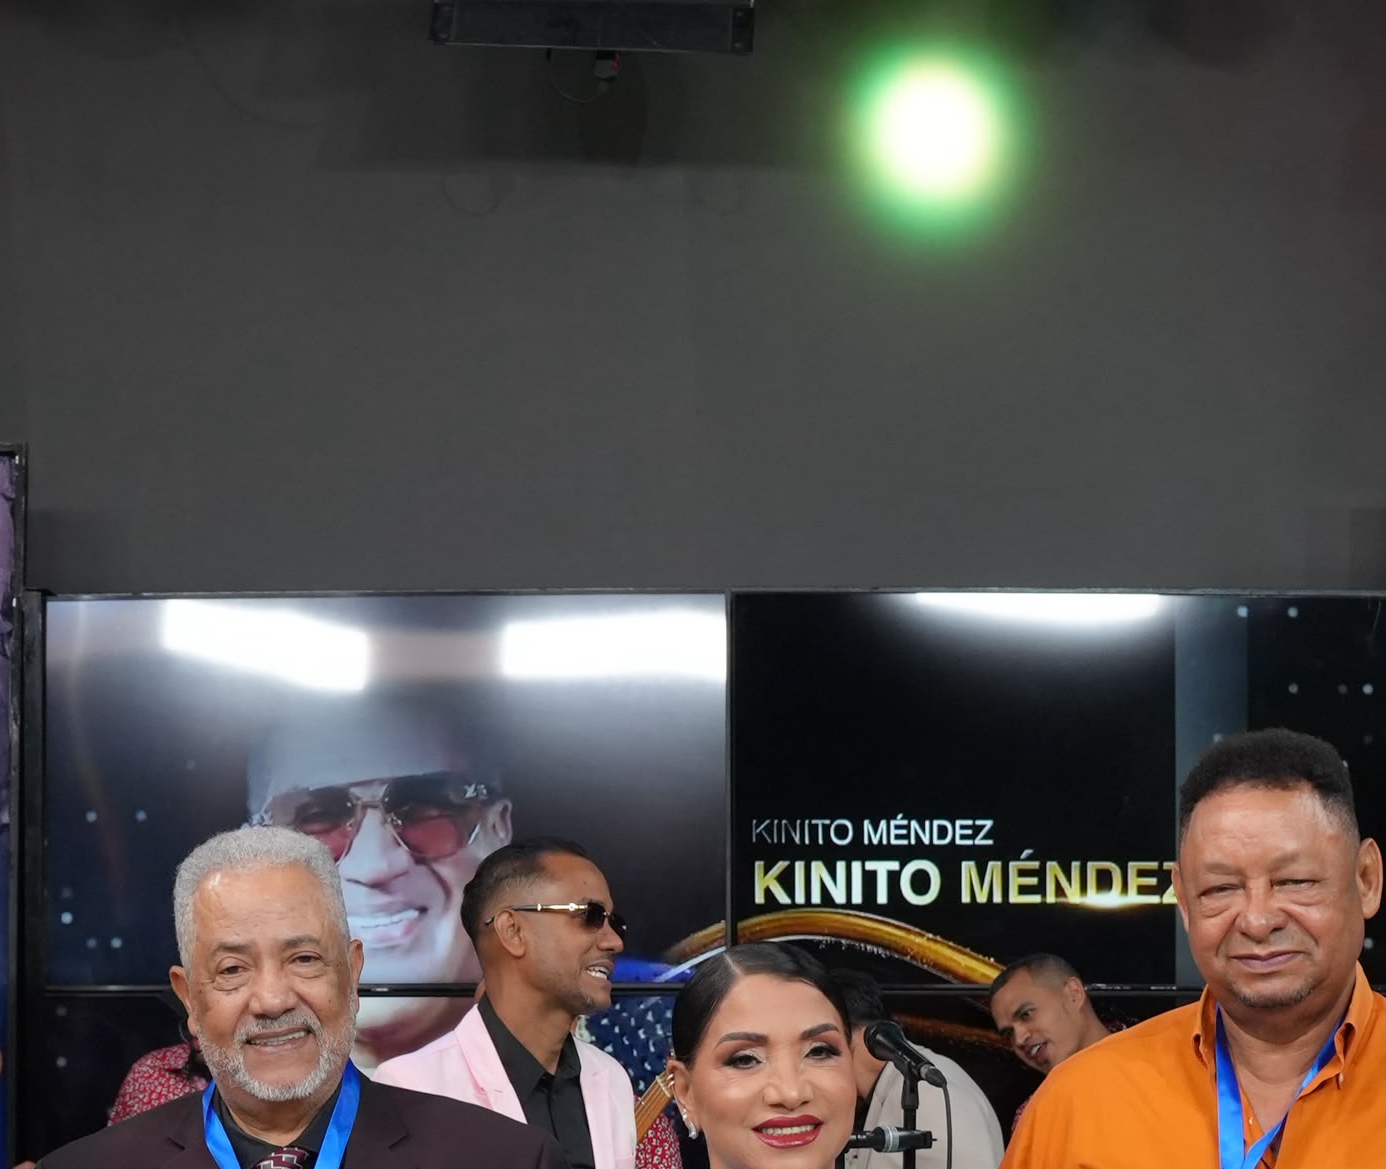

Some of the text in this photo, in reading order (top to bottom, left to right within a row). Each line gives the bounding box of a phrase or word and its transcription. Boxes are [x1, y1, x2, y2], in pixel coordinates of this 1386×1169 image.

[752, 813, 994, 845] KINITO MÉNDEZ
[753, 859, 941, 905] KINITO
